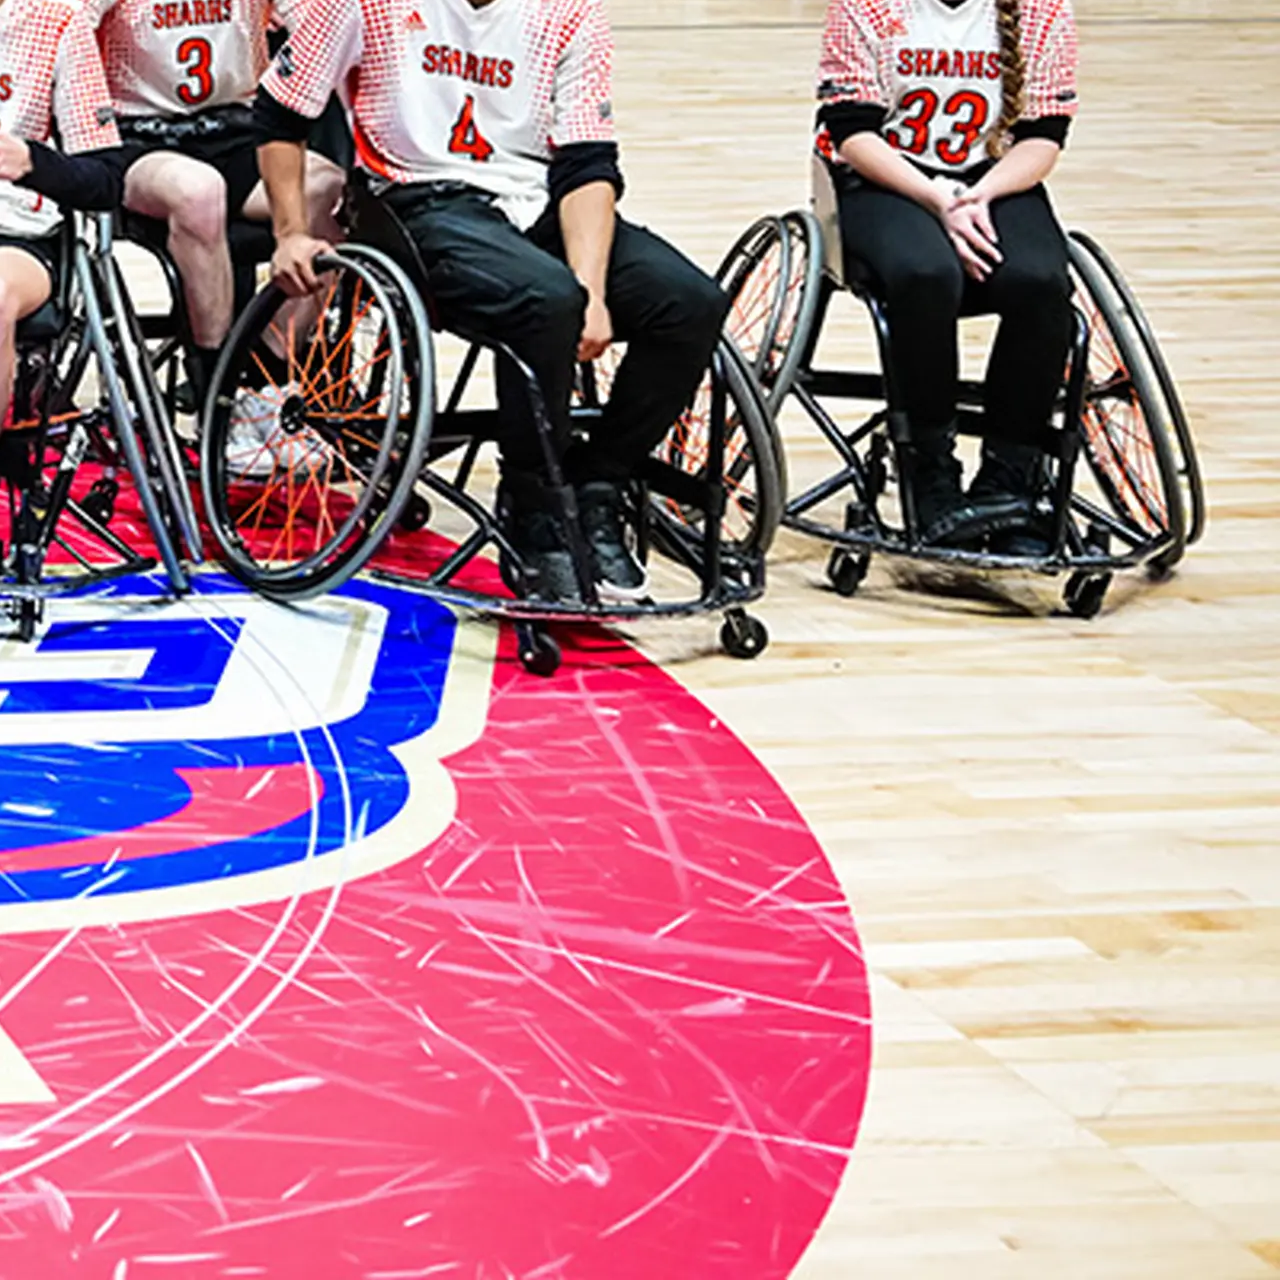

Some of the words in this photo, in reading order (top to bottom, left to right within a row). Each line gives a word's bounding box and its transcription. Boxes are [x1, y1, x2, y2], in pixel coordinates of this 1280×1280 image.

[175, 36, 214, 105] 3
[422, 43, 514, 88] SHARKS
[897, 47, 1001, 80] SHARKS
[447, 93, 494, 162] 4
[886, 89, 989, 165] 33
